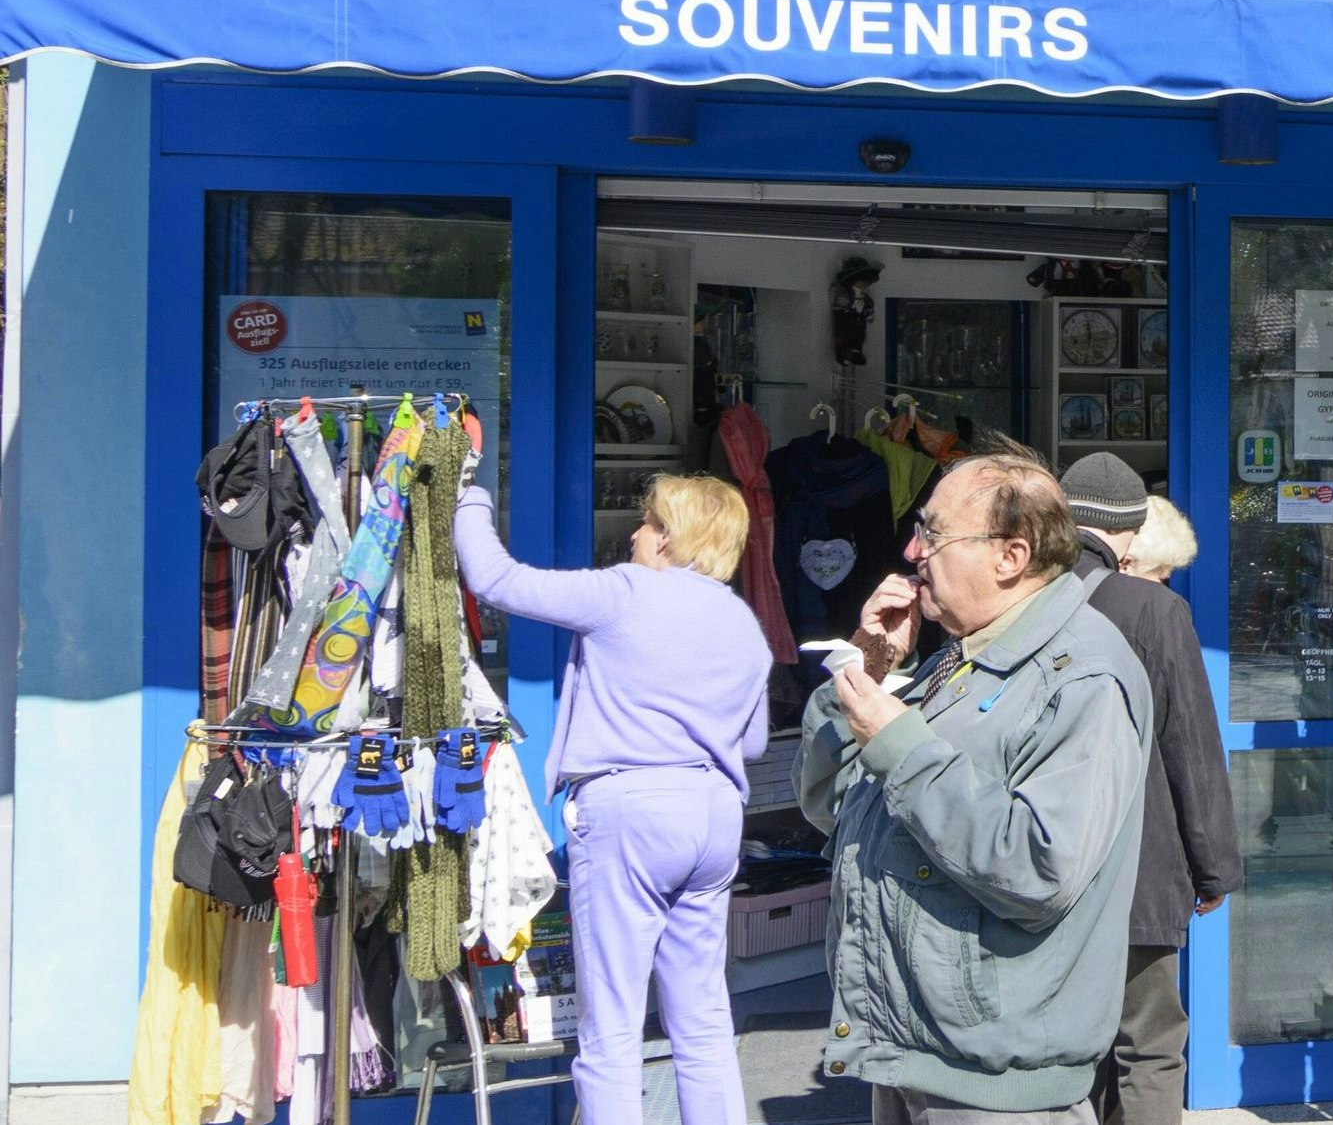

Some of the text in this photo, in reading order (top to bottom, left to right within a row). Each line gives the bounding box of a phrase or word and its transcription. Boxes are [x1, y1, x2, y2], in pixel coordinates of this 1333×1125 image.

[233, 313, 278, 330] CARD
[258, 357, 471, 373] 325 Ausflugsziele entdecken
[270, 377, 296, 389] Jahr
[300, 377, 334, 389] freier
[385, 380, 406, 389] um
[411, 380, 432, 389] nur
